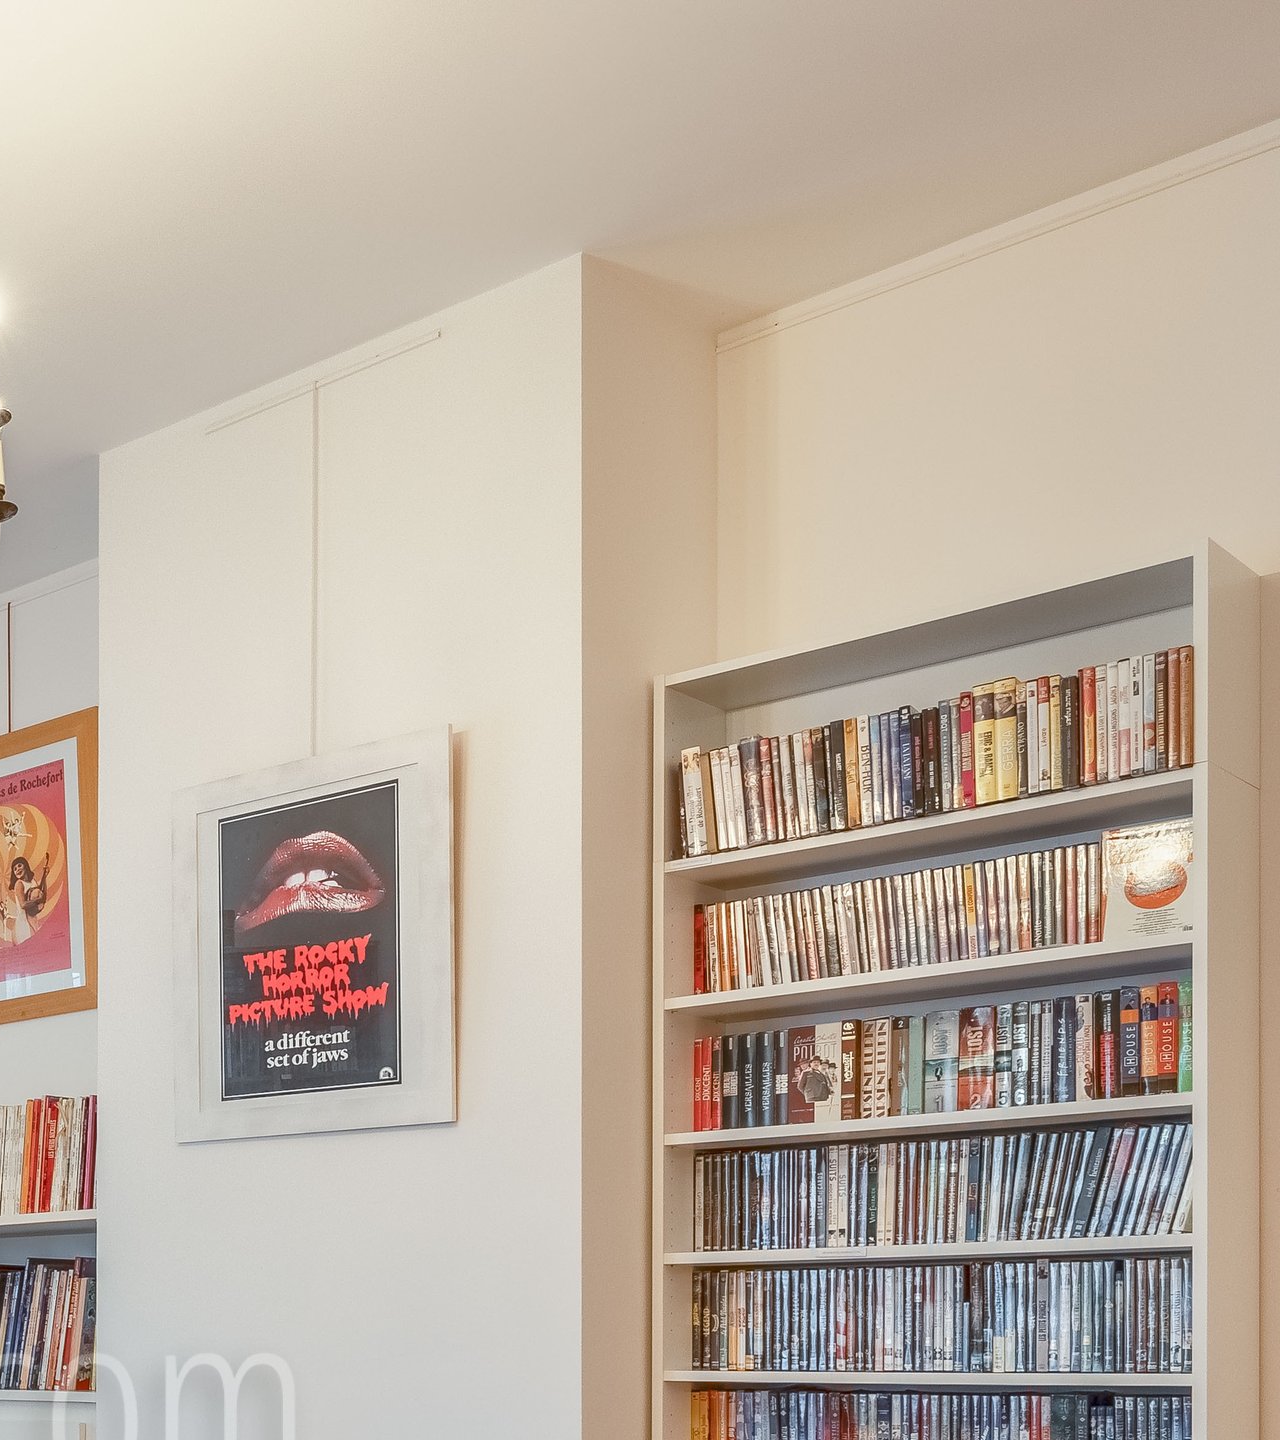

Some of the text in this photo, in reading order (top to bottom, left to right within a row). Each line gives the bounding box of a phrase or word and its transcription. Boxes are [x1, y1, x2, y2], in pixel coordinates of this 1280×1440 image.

[984, 731, 993, 746] ERIC
[1002, 730, 1013, 771] GERRA
[1017, 722, 1026, 753] CYRANO
[7, 784, 18, 796] de
[20, 769, 64, 793] Rochefort
[860, 745, 871, 794] BEN-HUR
[243, 933, 371, 978] THE ROCKY
[263, 964, 349, 995] HORROR
[229, 983, 389, 1031] PICTURE SHOW
[264, 1029, 350, 1052] a different
[932, 1029, 947, 1056] LOST
[966, 1026, 983, 1052] LOST
[997, 1026, 1008, 1045] LOST
[1013, 1024, 1026, 1044] LOST
[1124, 1026, 1136, 1066] HOUSE
[1143, 1025, 1156, 1063] HOUSE
[1160, 1021, 1173, 1061] HOUSE
[1182, 1021, 1192, 1062] HOUSE
[266, 1046, 349, 1068] set of jaws
[744, 1064, 753, 1113] VERSAILLES
[762, 1062, 771, 1111] VERSAILLES
[780, 1073, 788, 1094] NOIR
